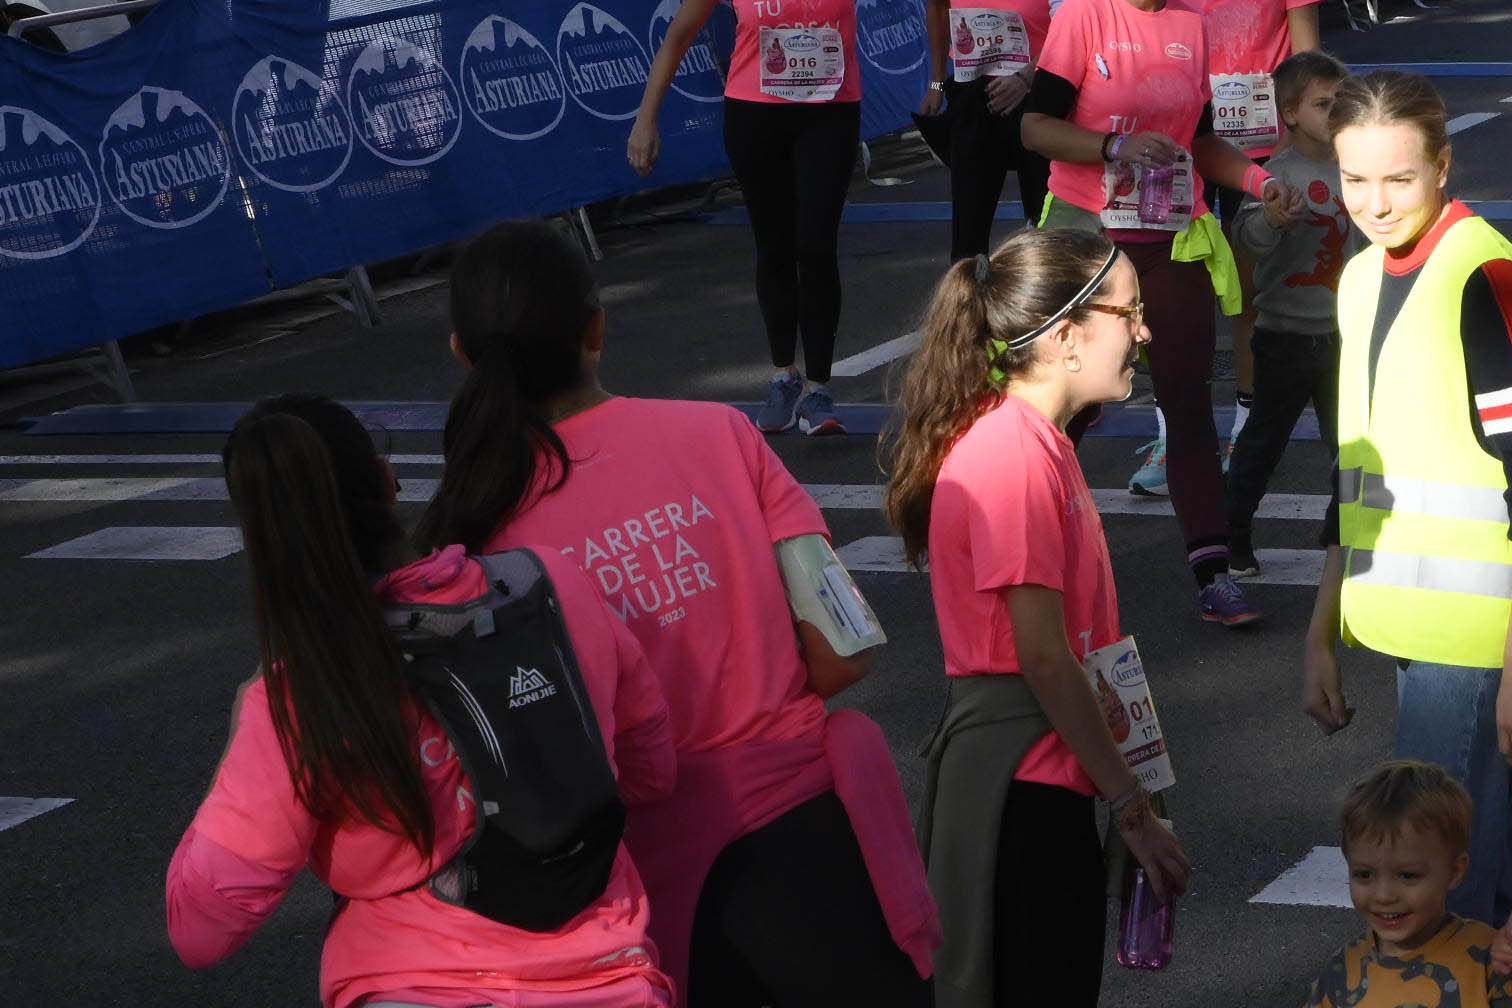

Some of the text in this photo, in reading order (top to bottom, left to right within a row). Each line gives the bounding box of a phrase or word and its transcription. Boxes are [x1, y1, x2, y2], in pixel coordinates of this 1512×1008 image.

[753, 0, 782, 18] TU
[976, 35, 1004, 47] 016
[565, 49, 648, 96] ASTURIANA
[788, 57, 817, 68] 016
[470, 65, 562, 115] ASTURIANA
[1109, 115, 1138, 134] TU
[1218, 106, 1247, 118] 016
[1222, 120, 1245, 129] 12335
[244, 112, 348, 164] ASTURIANA
[113, 142, 224, 202] ASTURIANA
[597, 533, 699, 595] DE LA
[606, 561, 718, 624] MUJER
[656, 606, 689, 629] 2023
[507, 683, 558, 710] AONIJIE
